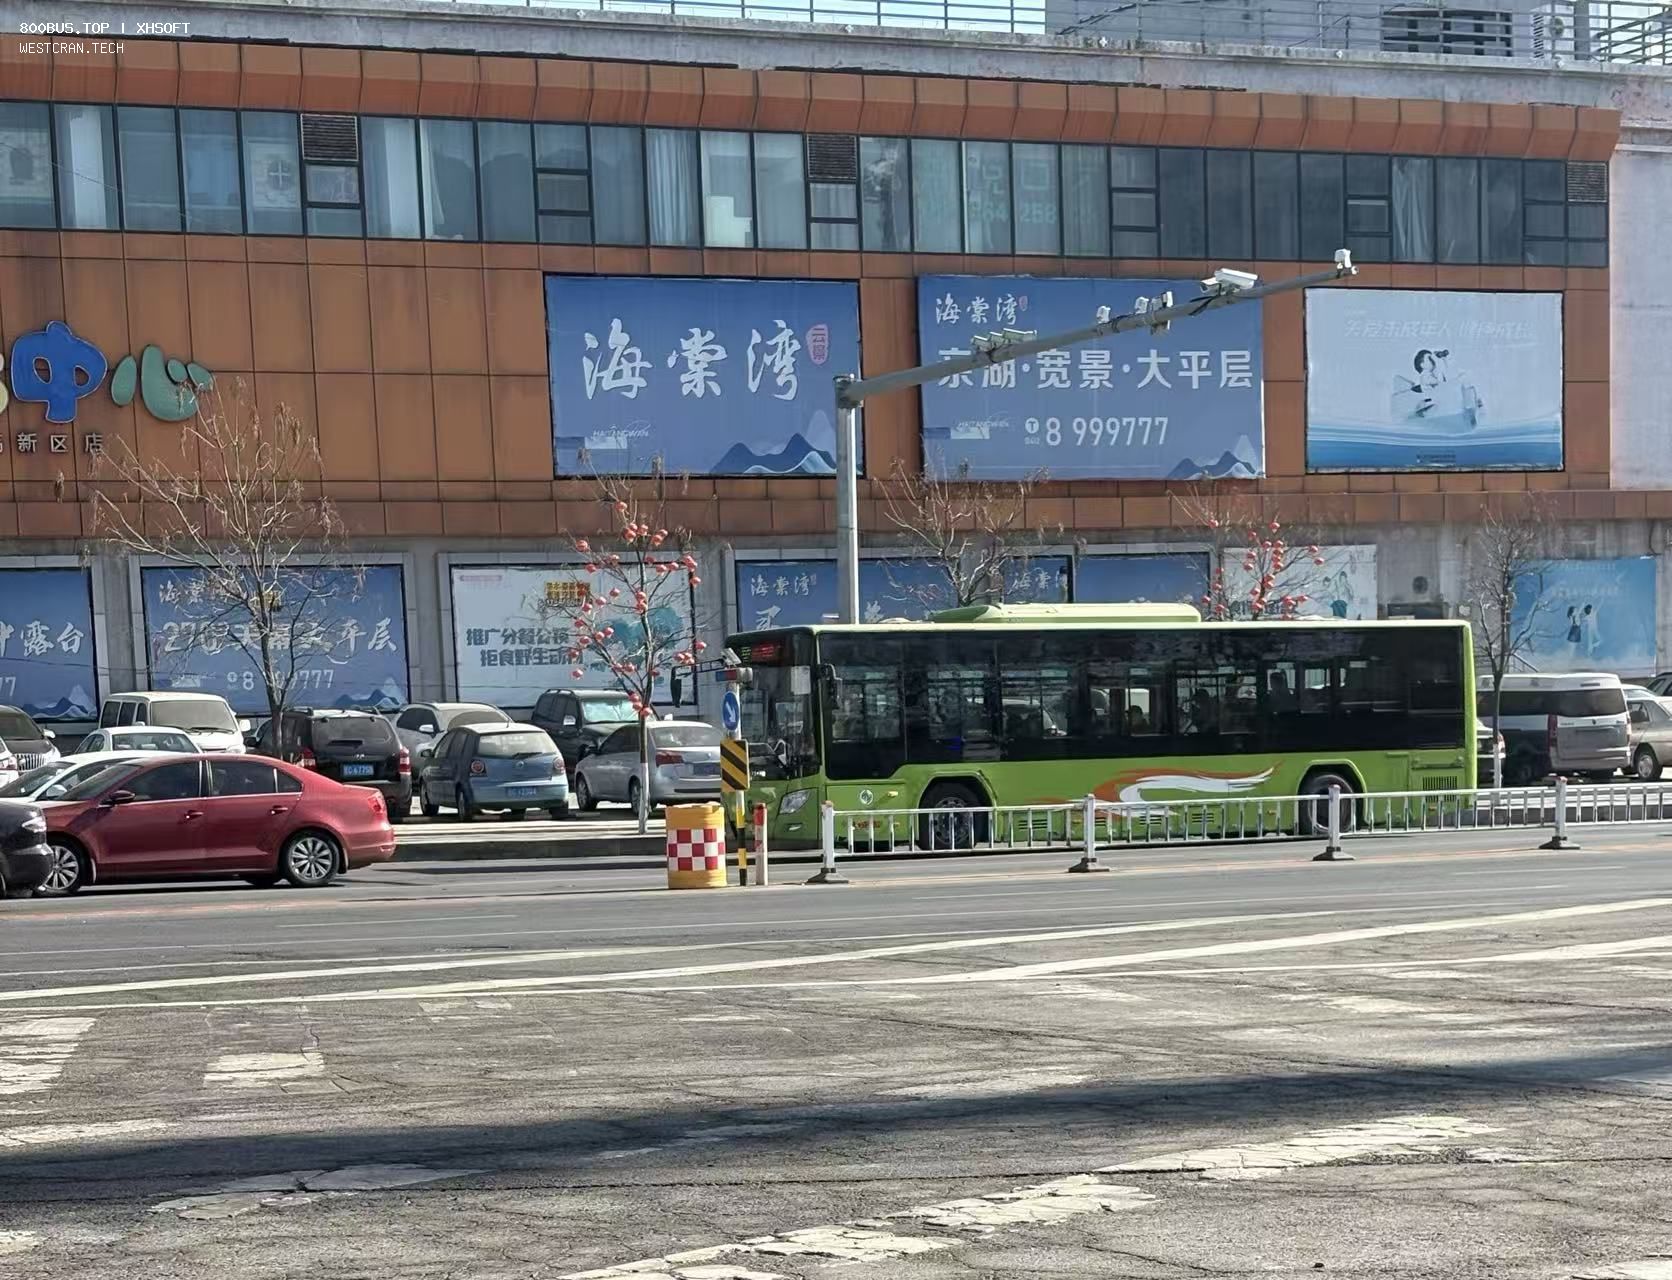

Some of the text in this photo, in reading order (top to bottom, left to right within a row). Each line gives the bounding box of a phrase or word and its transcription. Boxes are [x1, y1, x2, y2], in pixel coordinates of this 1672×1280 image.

[935, 292, 1018, 325] 海棠湾
[0, 320, 214, 424] 中心
[582, 317, 801, 401] 海棠湾
[0, 431, 103, 453] 新区店
[1045, 417, 1062, 446] 8
[1072, 416, 1168, 446] 999777
[750, 572, 810, 597] 海棠湾
[242, 670, 255, 691] 8
